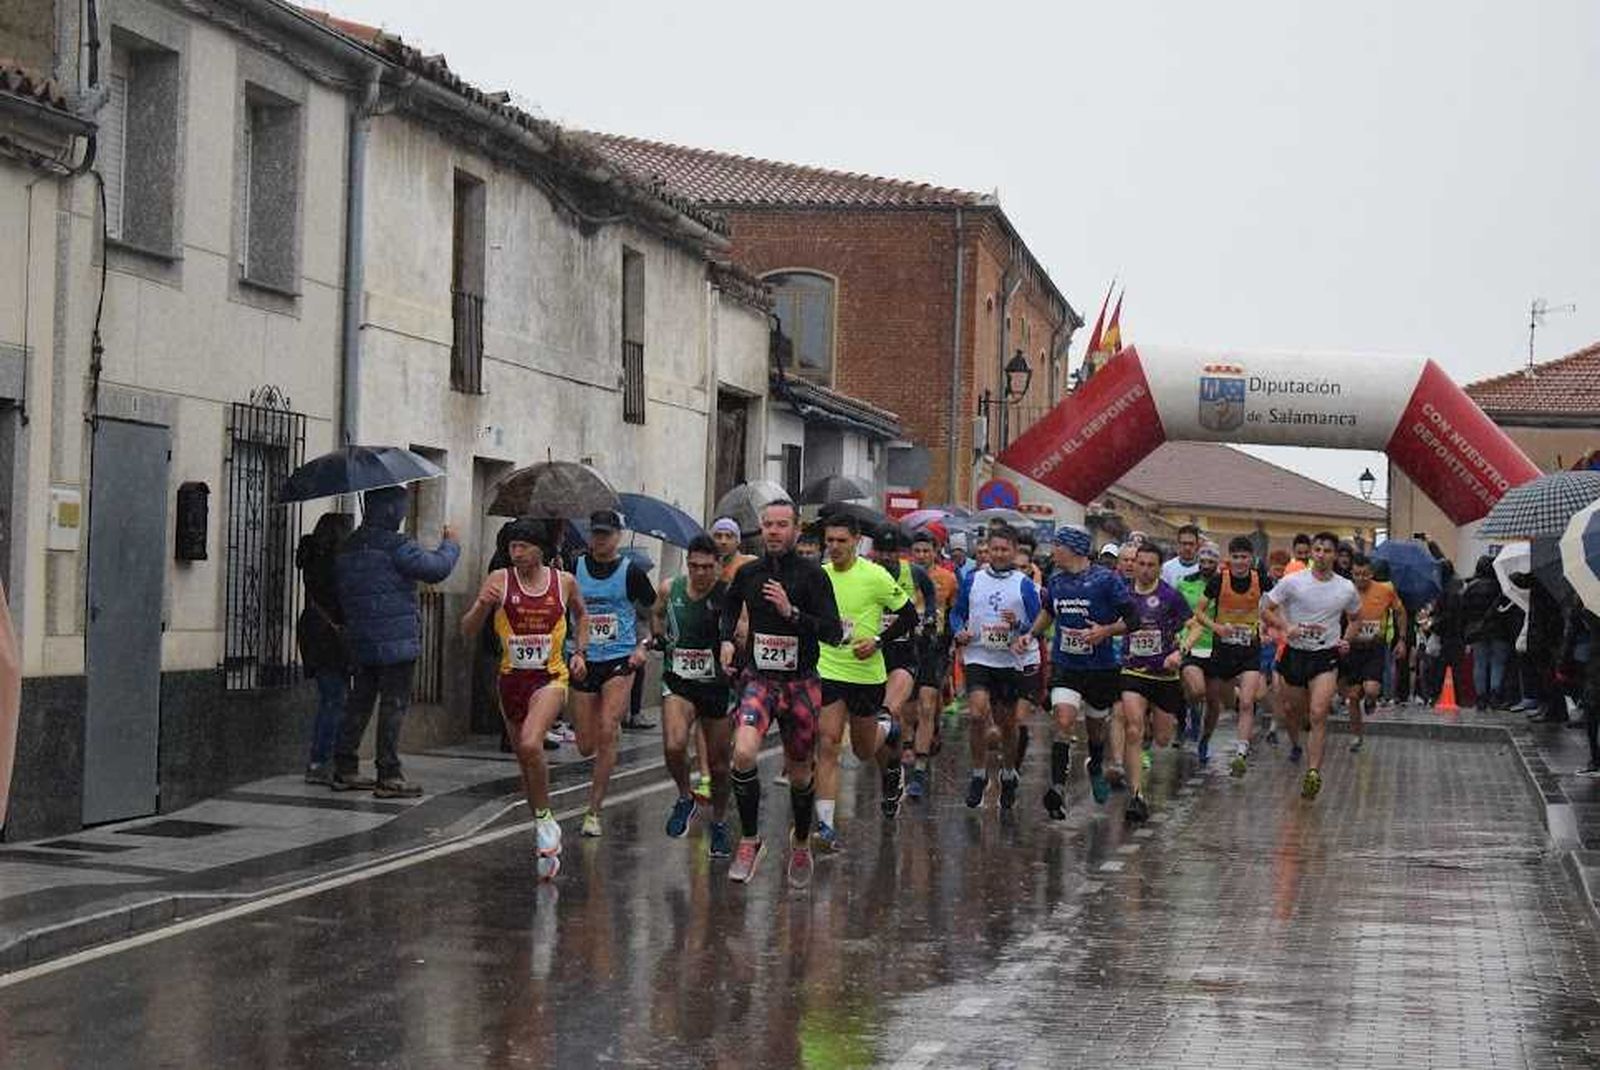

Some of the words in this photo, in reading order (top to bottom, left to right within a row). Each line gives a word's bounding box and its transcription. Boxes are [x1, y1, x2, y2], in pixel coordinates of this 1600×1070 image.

[1249, 376, 1341, 396] Diputación
[1246, 410, 1261, 422] de
[1269, 408, 1357, 426] Salamanca
[1422, 403, 1453, 433] CON
[1031, 452, 1062, 479] CON
[1061, 436, 1084, 454] EL
[1081, 384, 1147, 439] DEPORTE
[516, 647, 543, 660] 391
[761, 647, 786, 662] 221
